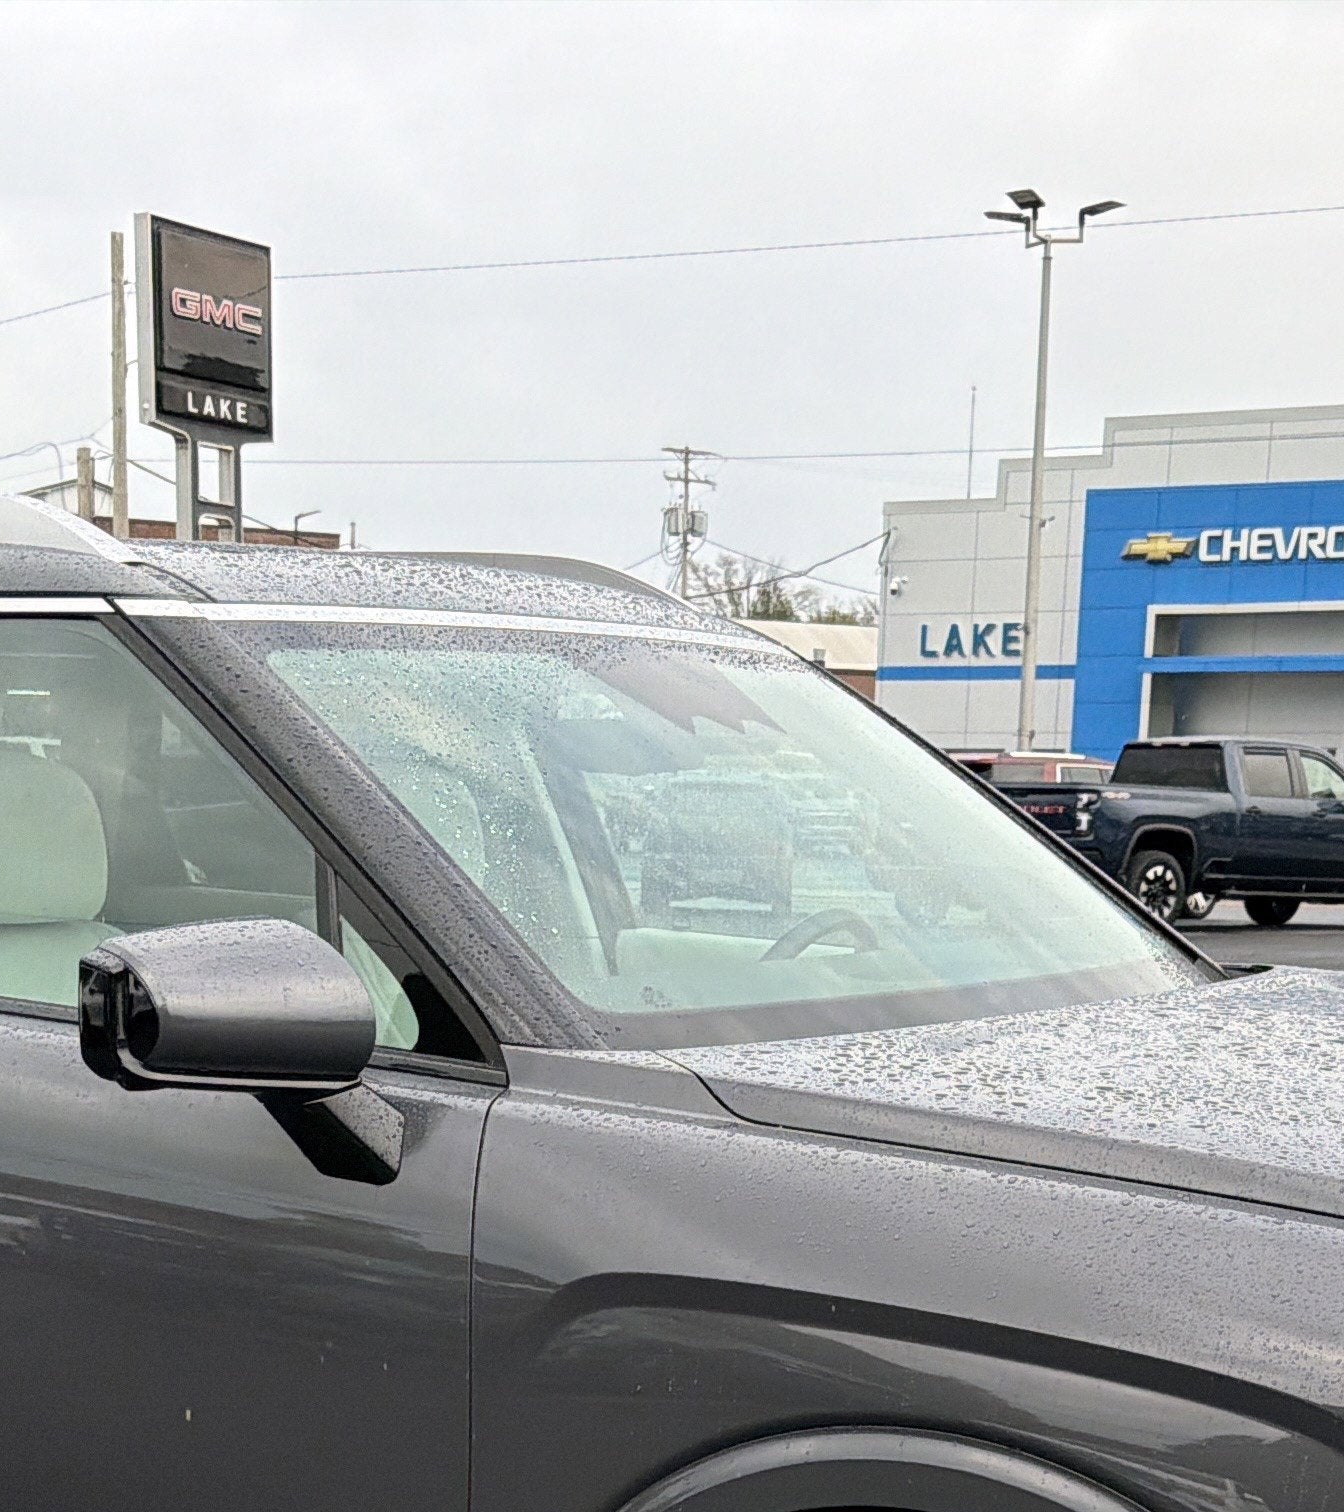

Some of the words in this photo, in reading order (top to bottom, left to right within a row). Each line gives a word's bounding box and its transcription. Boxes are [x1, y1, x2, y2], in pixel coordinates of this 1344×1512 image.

[171, 287, 263, 335] GMC
[187, 391, 248, 423] LAKE
[919, 623, 1023, 658] LAKE
